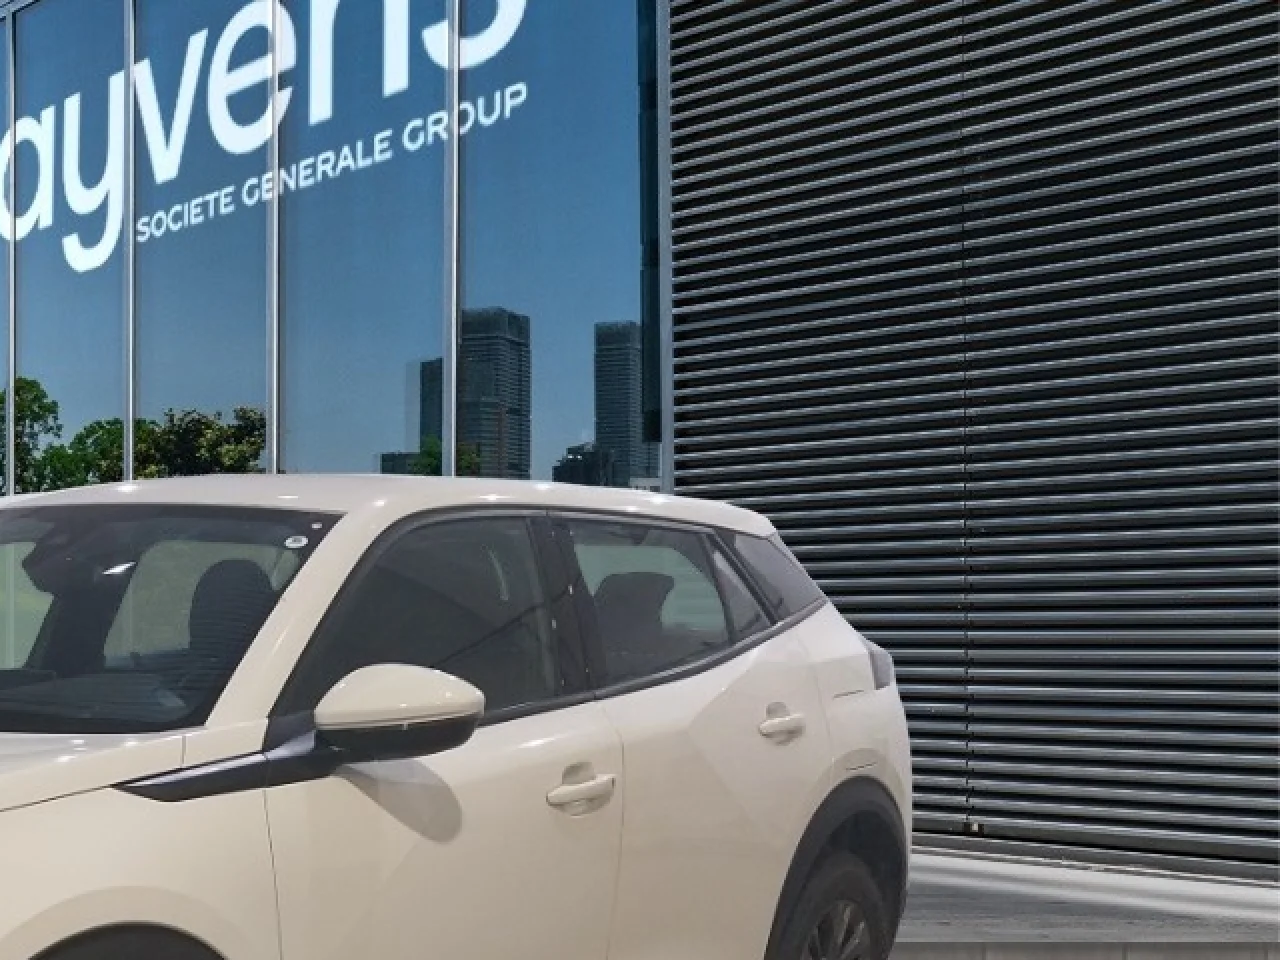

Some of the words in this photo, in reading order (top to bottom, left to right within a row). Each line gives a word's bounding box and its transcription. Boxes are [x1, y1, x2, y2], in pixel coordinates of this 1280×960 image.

[135, 184, 237, 243] SOCIETE
[241, 128, 394, 207] GENERALE
[401, 81, 528, 152] GROUP
